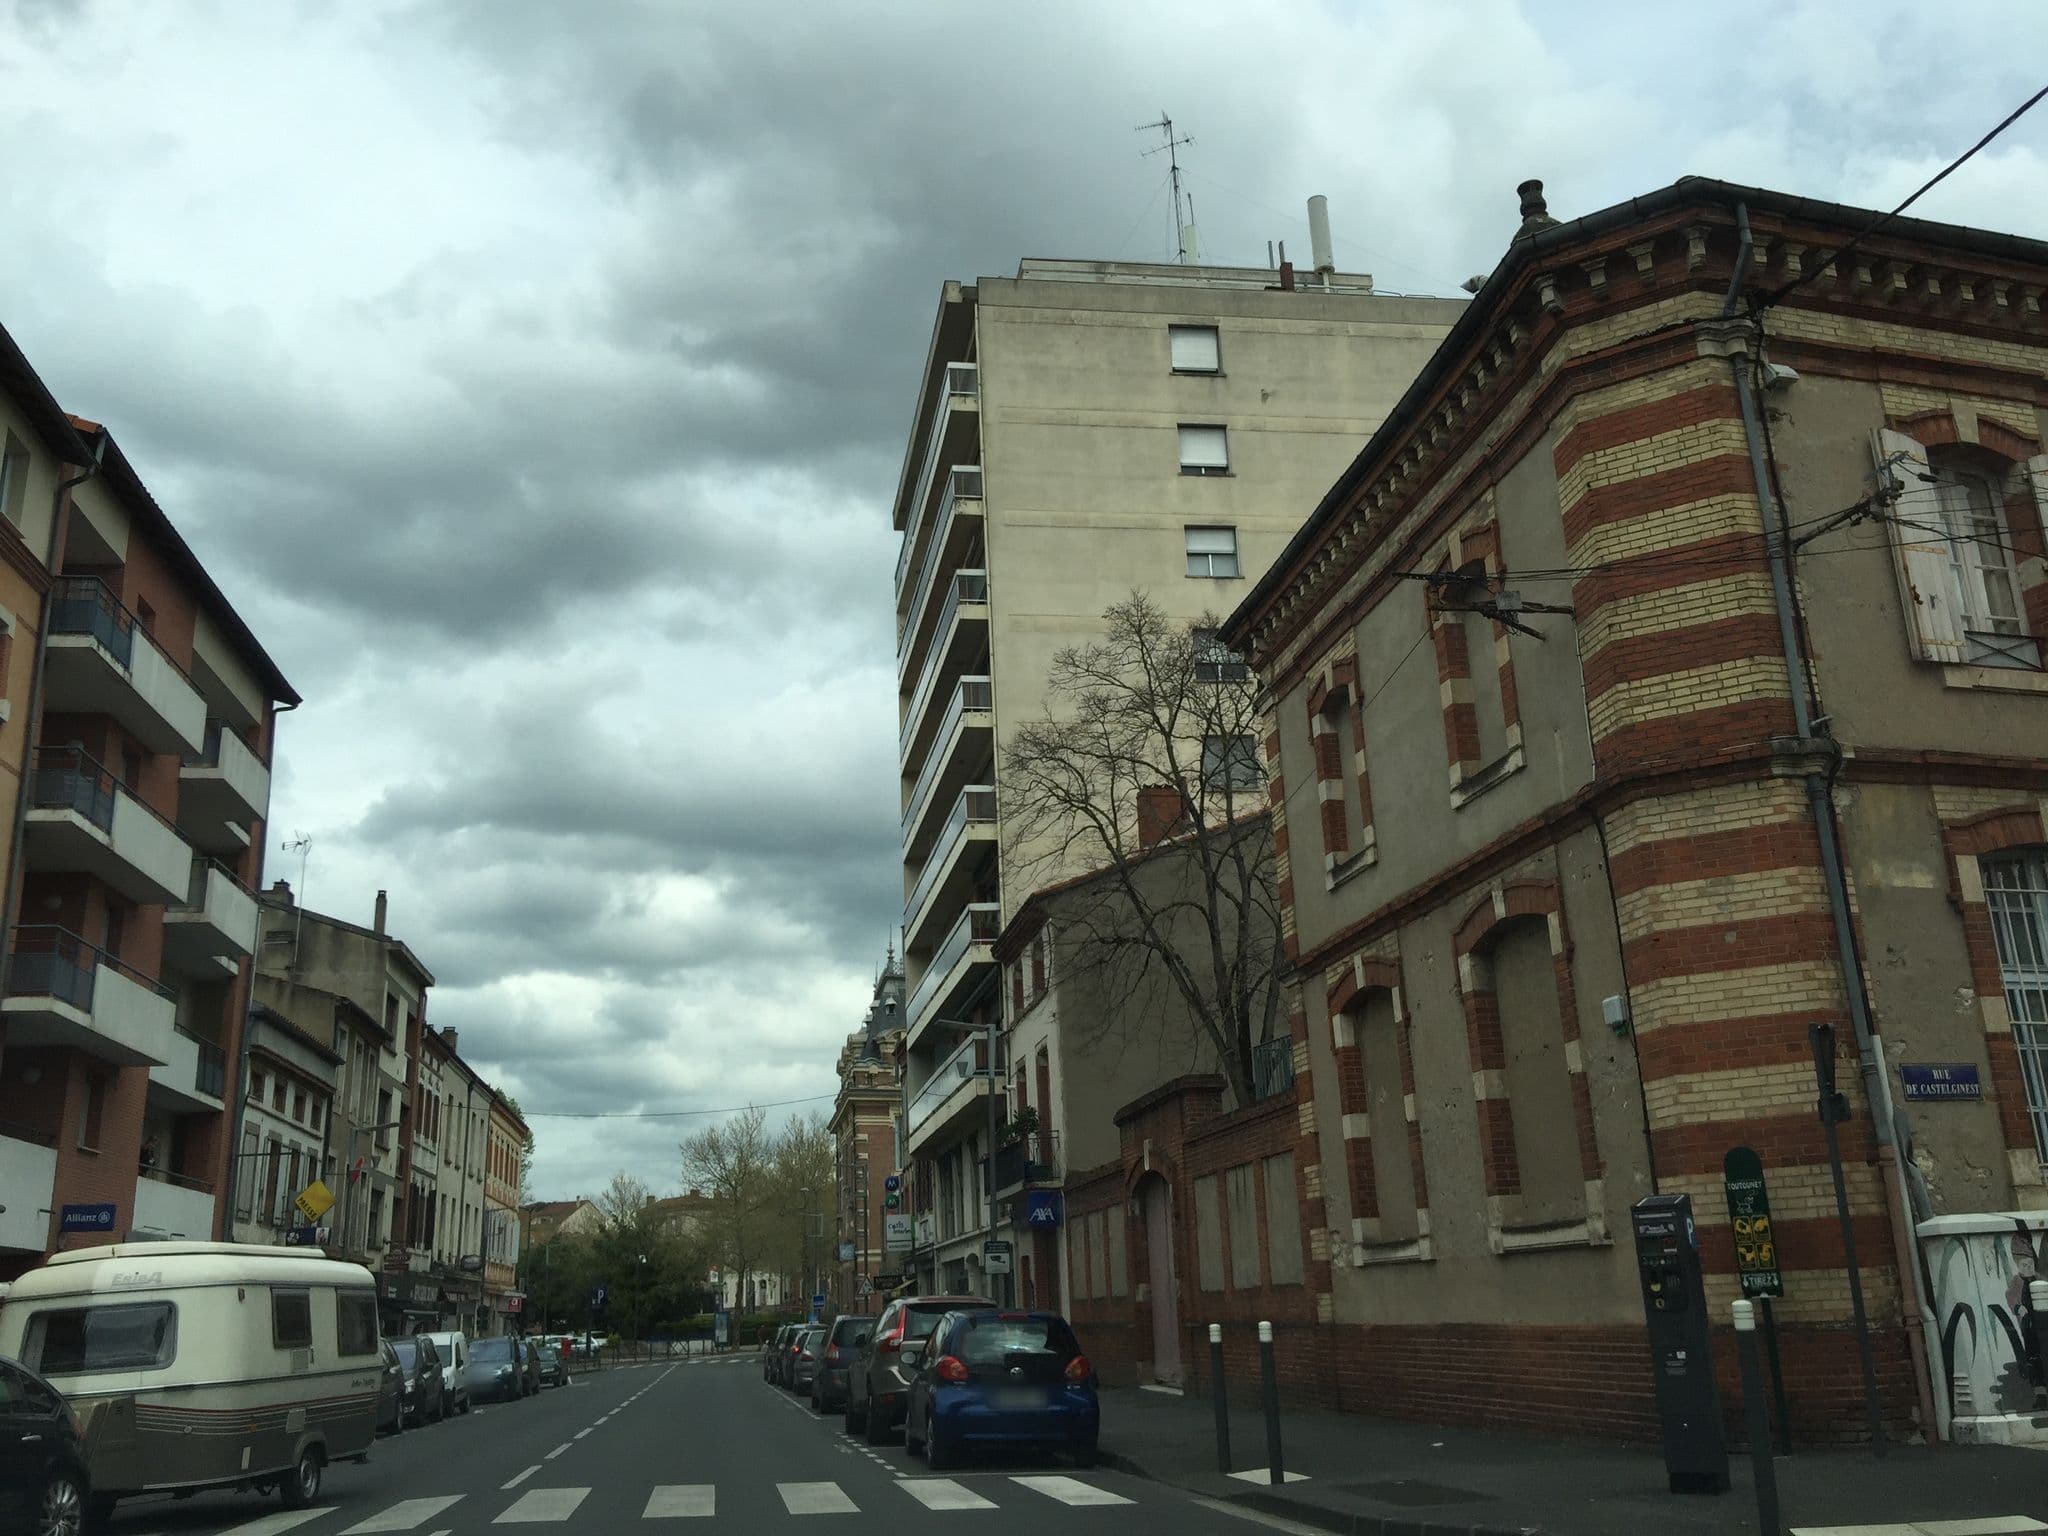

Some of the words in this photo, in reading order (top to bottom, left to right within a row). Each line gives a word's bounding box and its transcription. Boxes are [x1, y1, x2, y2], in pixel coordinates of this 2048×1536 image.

[1932, 1069, 1951, 1080] RUE
[1906, 1084, 1918, 1095] DE
[1920, 1083, 1980, 1095] CASTELGINEST
[1727, 1181, 1763, 1192] TOUTOUNET
[297, 1196, 318, 1219] PRESSE
[65, 1213, 97, 1223] Allianz
[1028, 1207, 1056, 1222] AXA
[1686, 1217, 1695, 1245] P
[1748, 1275, 1772, 1288] TIREZ
